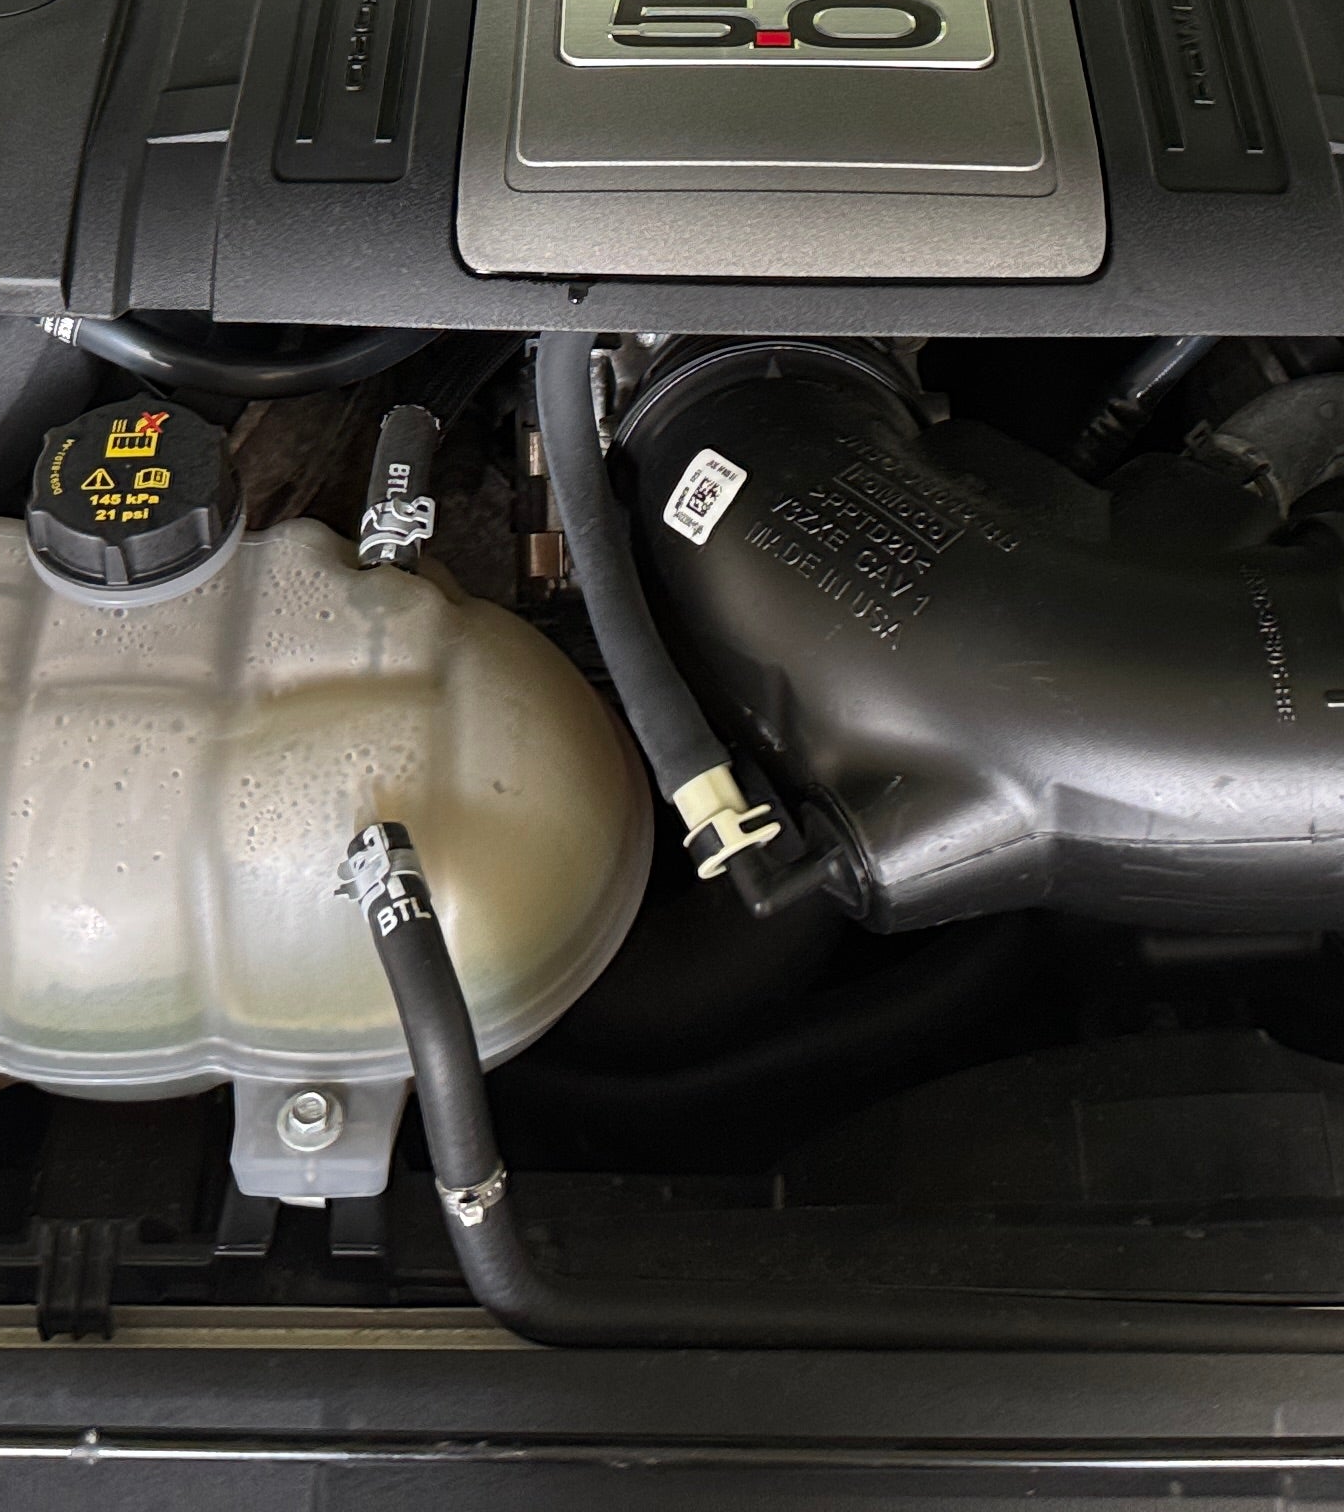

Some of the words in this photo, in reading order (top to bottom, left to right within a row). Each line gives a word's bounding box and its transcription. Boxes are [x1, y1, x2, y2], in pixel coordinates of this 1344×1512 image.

[89, 493, 122, 506] 145
[125, 493, 160, 505] kPa
[94, 509, 116, 521] 21
[121, 508, 150, 523] psi
[744, 520, 824, 580] MADE
[817, 568, 853, 602] IN
[851, 591, 904, 651] USA
[376, 896, 432, 937] BTL
